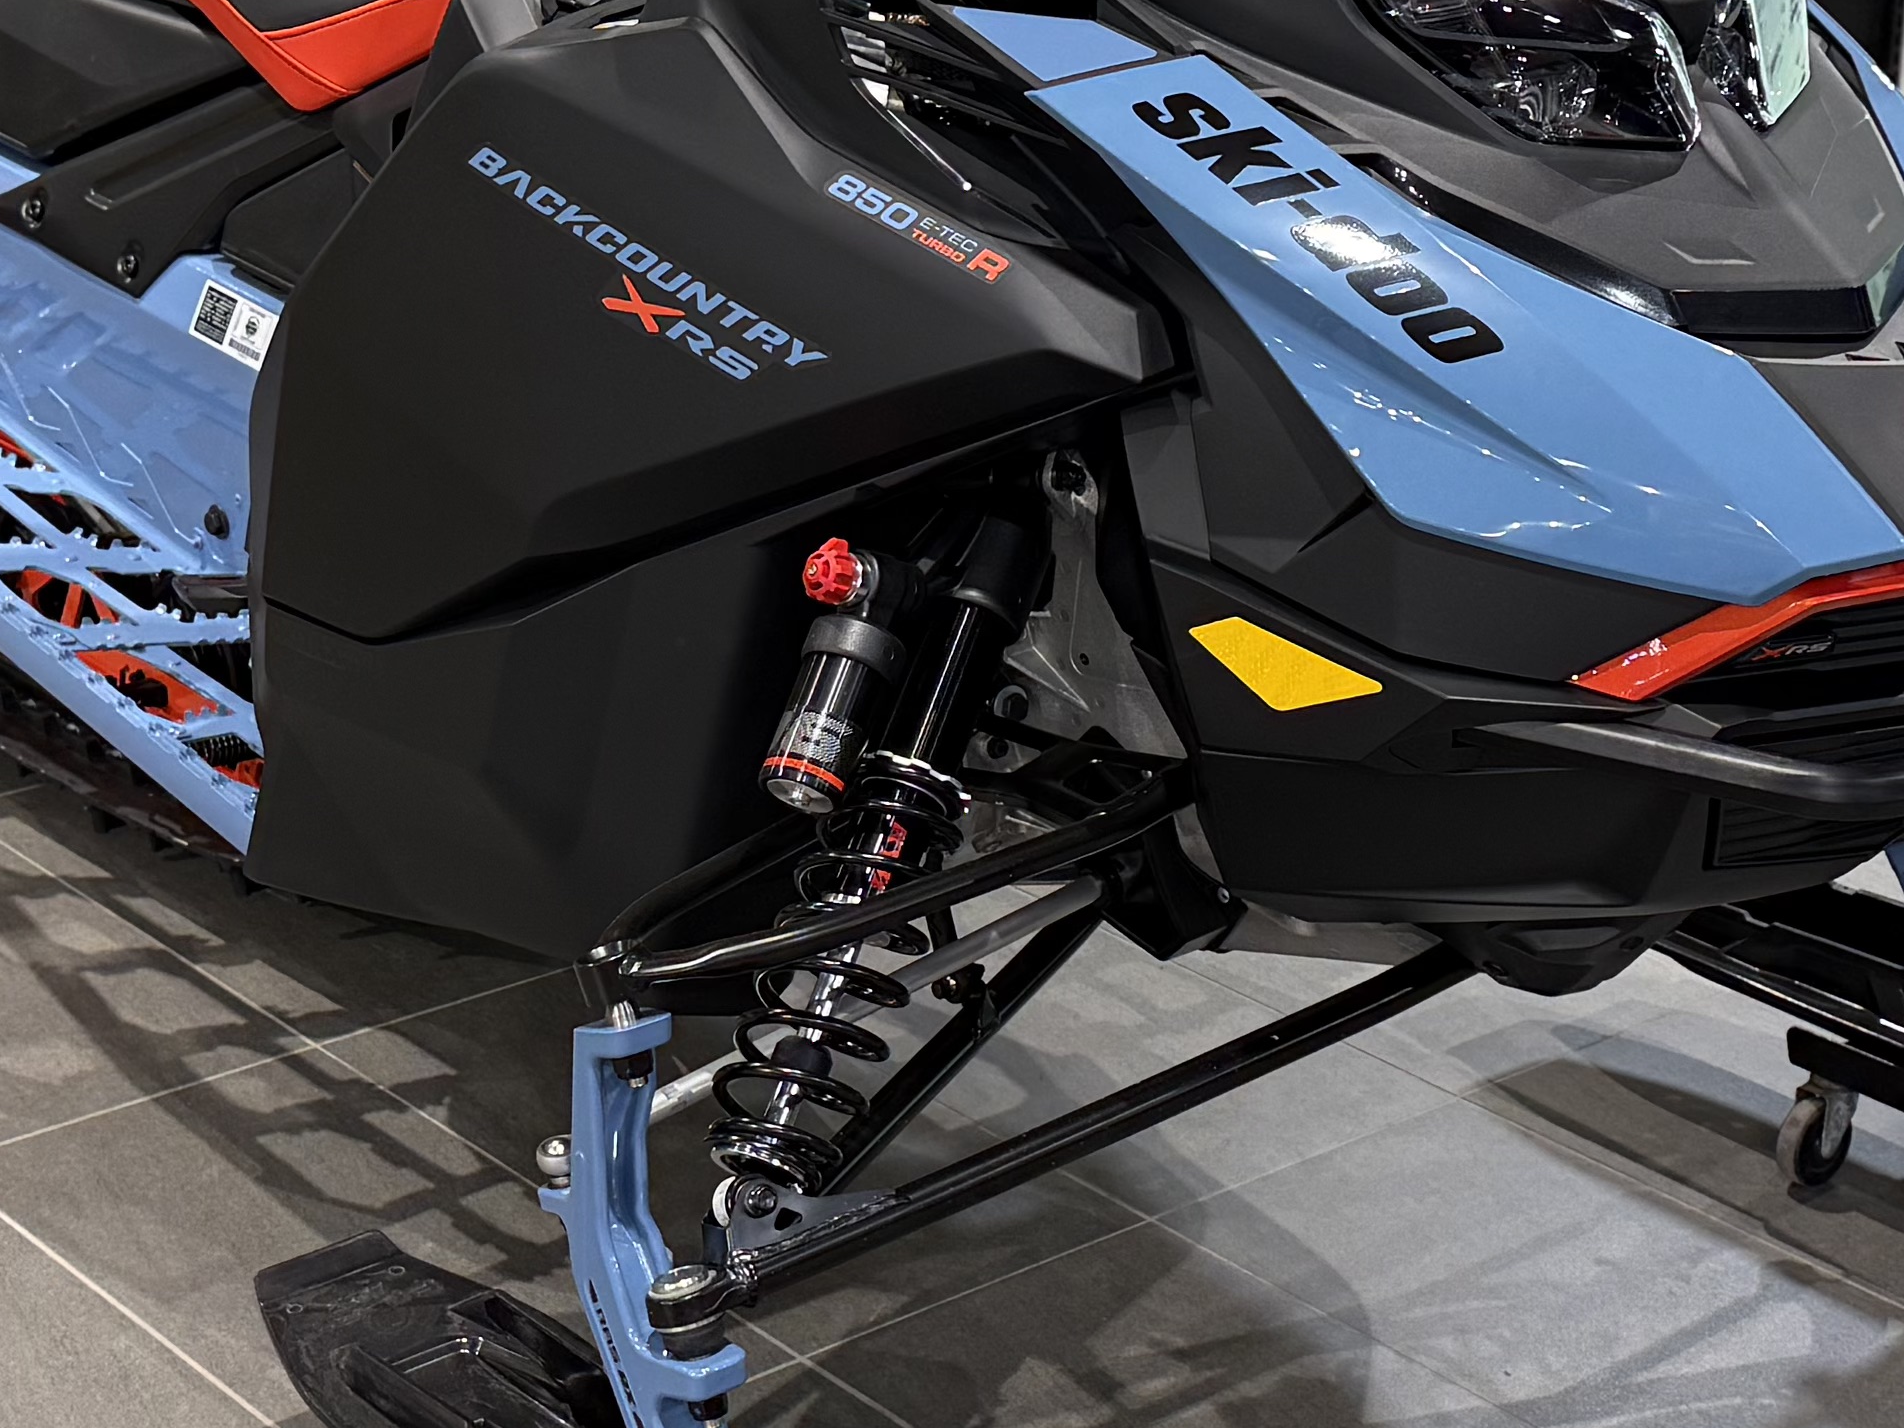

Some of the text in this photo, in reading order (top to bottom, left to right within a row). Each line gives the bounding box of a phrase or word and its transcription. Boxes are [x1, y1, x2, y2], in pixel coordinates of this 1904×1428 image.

[468, 147, 827, 367] BACKCOUNTRY
[828, 174, 1010, 281] 850 E-TEC R
[912, 228, 966, 263] TURBO
[1132, 92, 1505, 363] ski-doo
